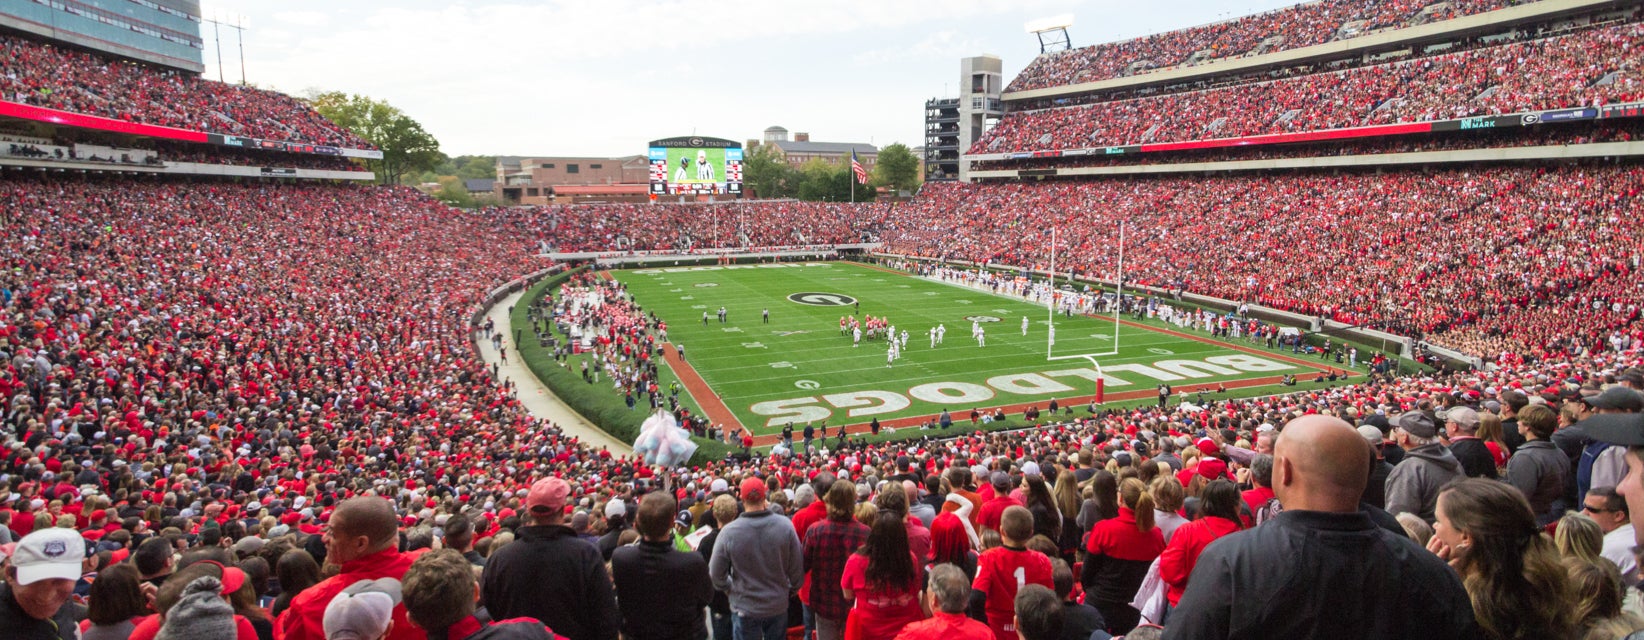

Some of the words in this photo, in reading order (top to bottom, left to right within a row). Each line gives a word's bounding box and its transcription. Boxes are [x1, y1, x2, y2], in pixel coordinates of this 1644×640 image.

[1472, 120, 1496, 128] MARK
[1524, 114, 1539, 124] G
[690, 137, 704, 147] G
[750, 353, 1298, 428] BULLDOGS
[1013, 566, 1025, 593] 1
